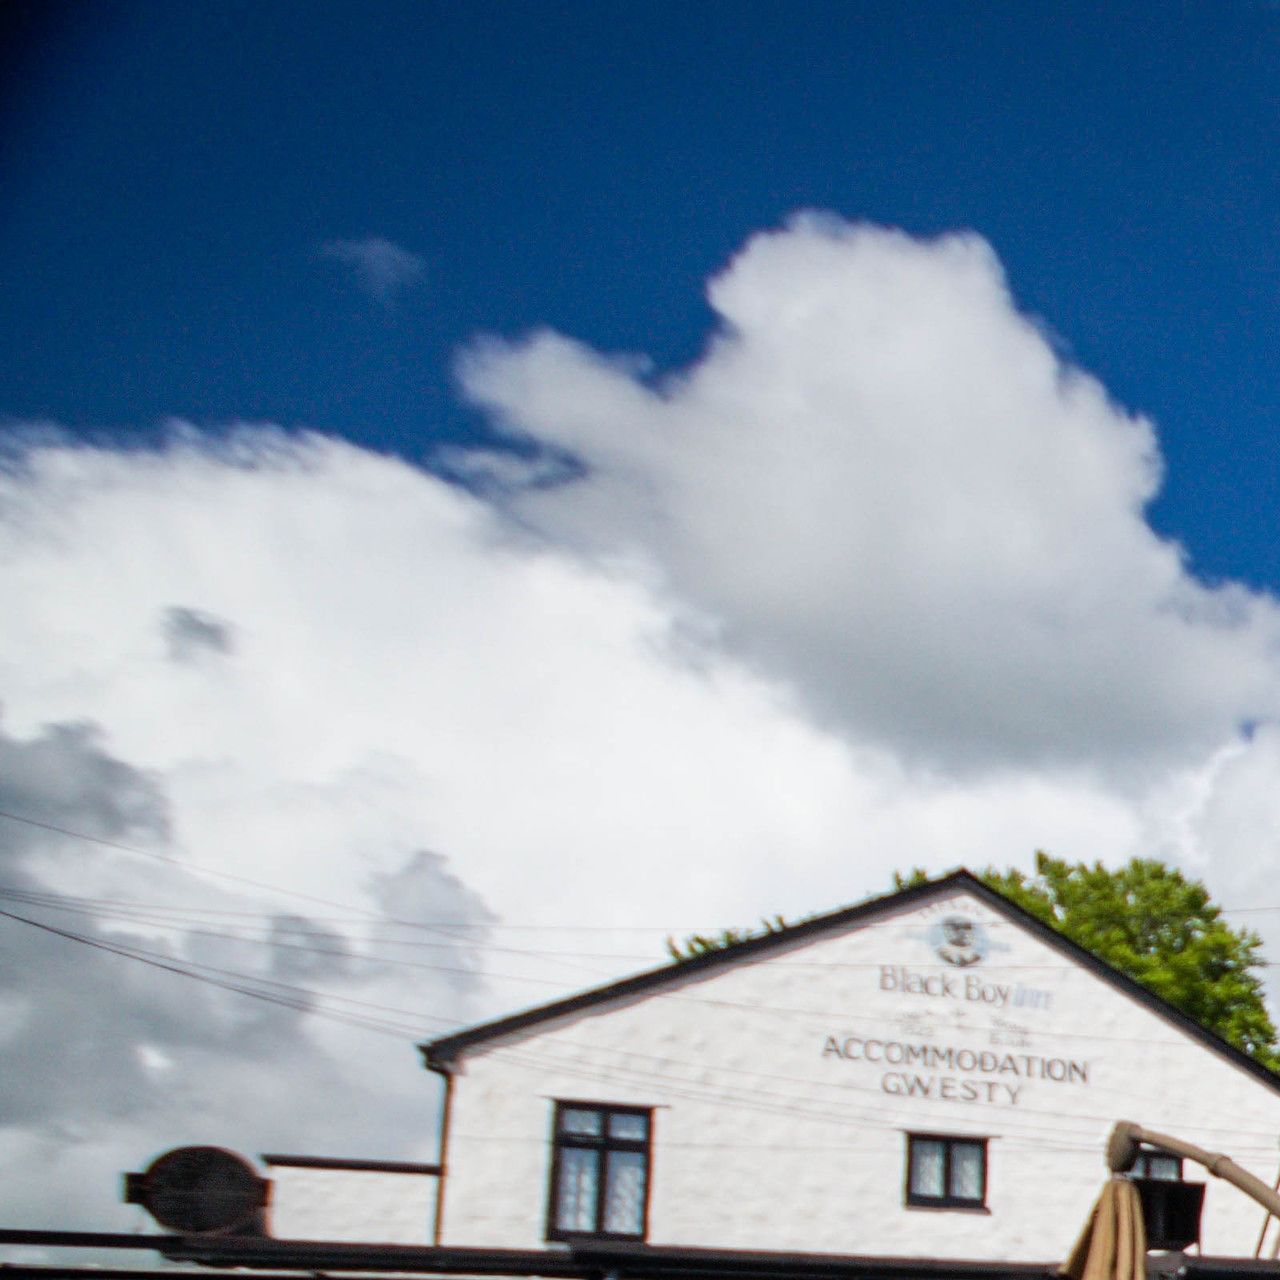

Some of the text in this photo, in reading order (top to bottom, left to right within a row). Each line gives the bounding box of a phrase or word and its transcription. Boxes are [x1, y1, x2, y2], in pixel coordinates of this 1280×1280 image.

[879, 965, 957, 998] Black
[965, 974, 1012, 1009] Boy
[822, 1035, 1090, 1084] ACCOMMODATION
[881, 1072, 1022, 1105] GWESTY
